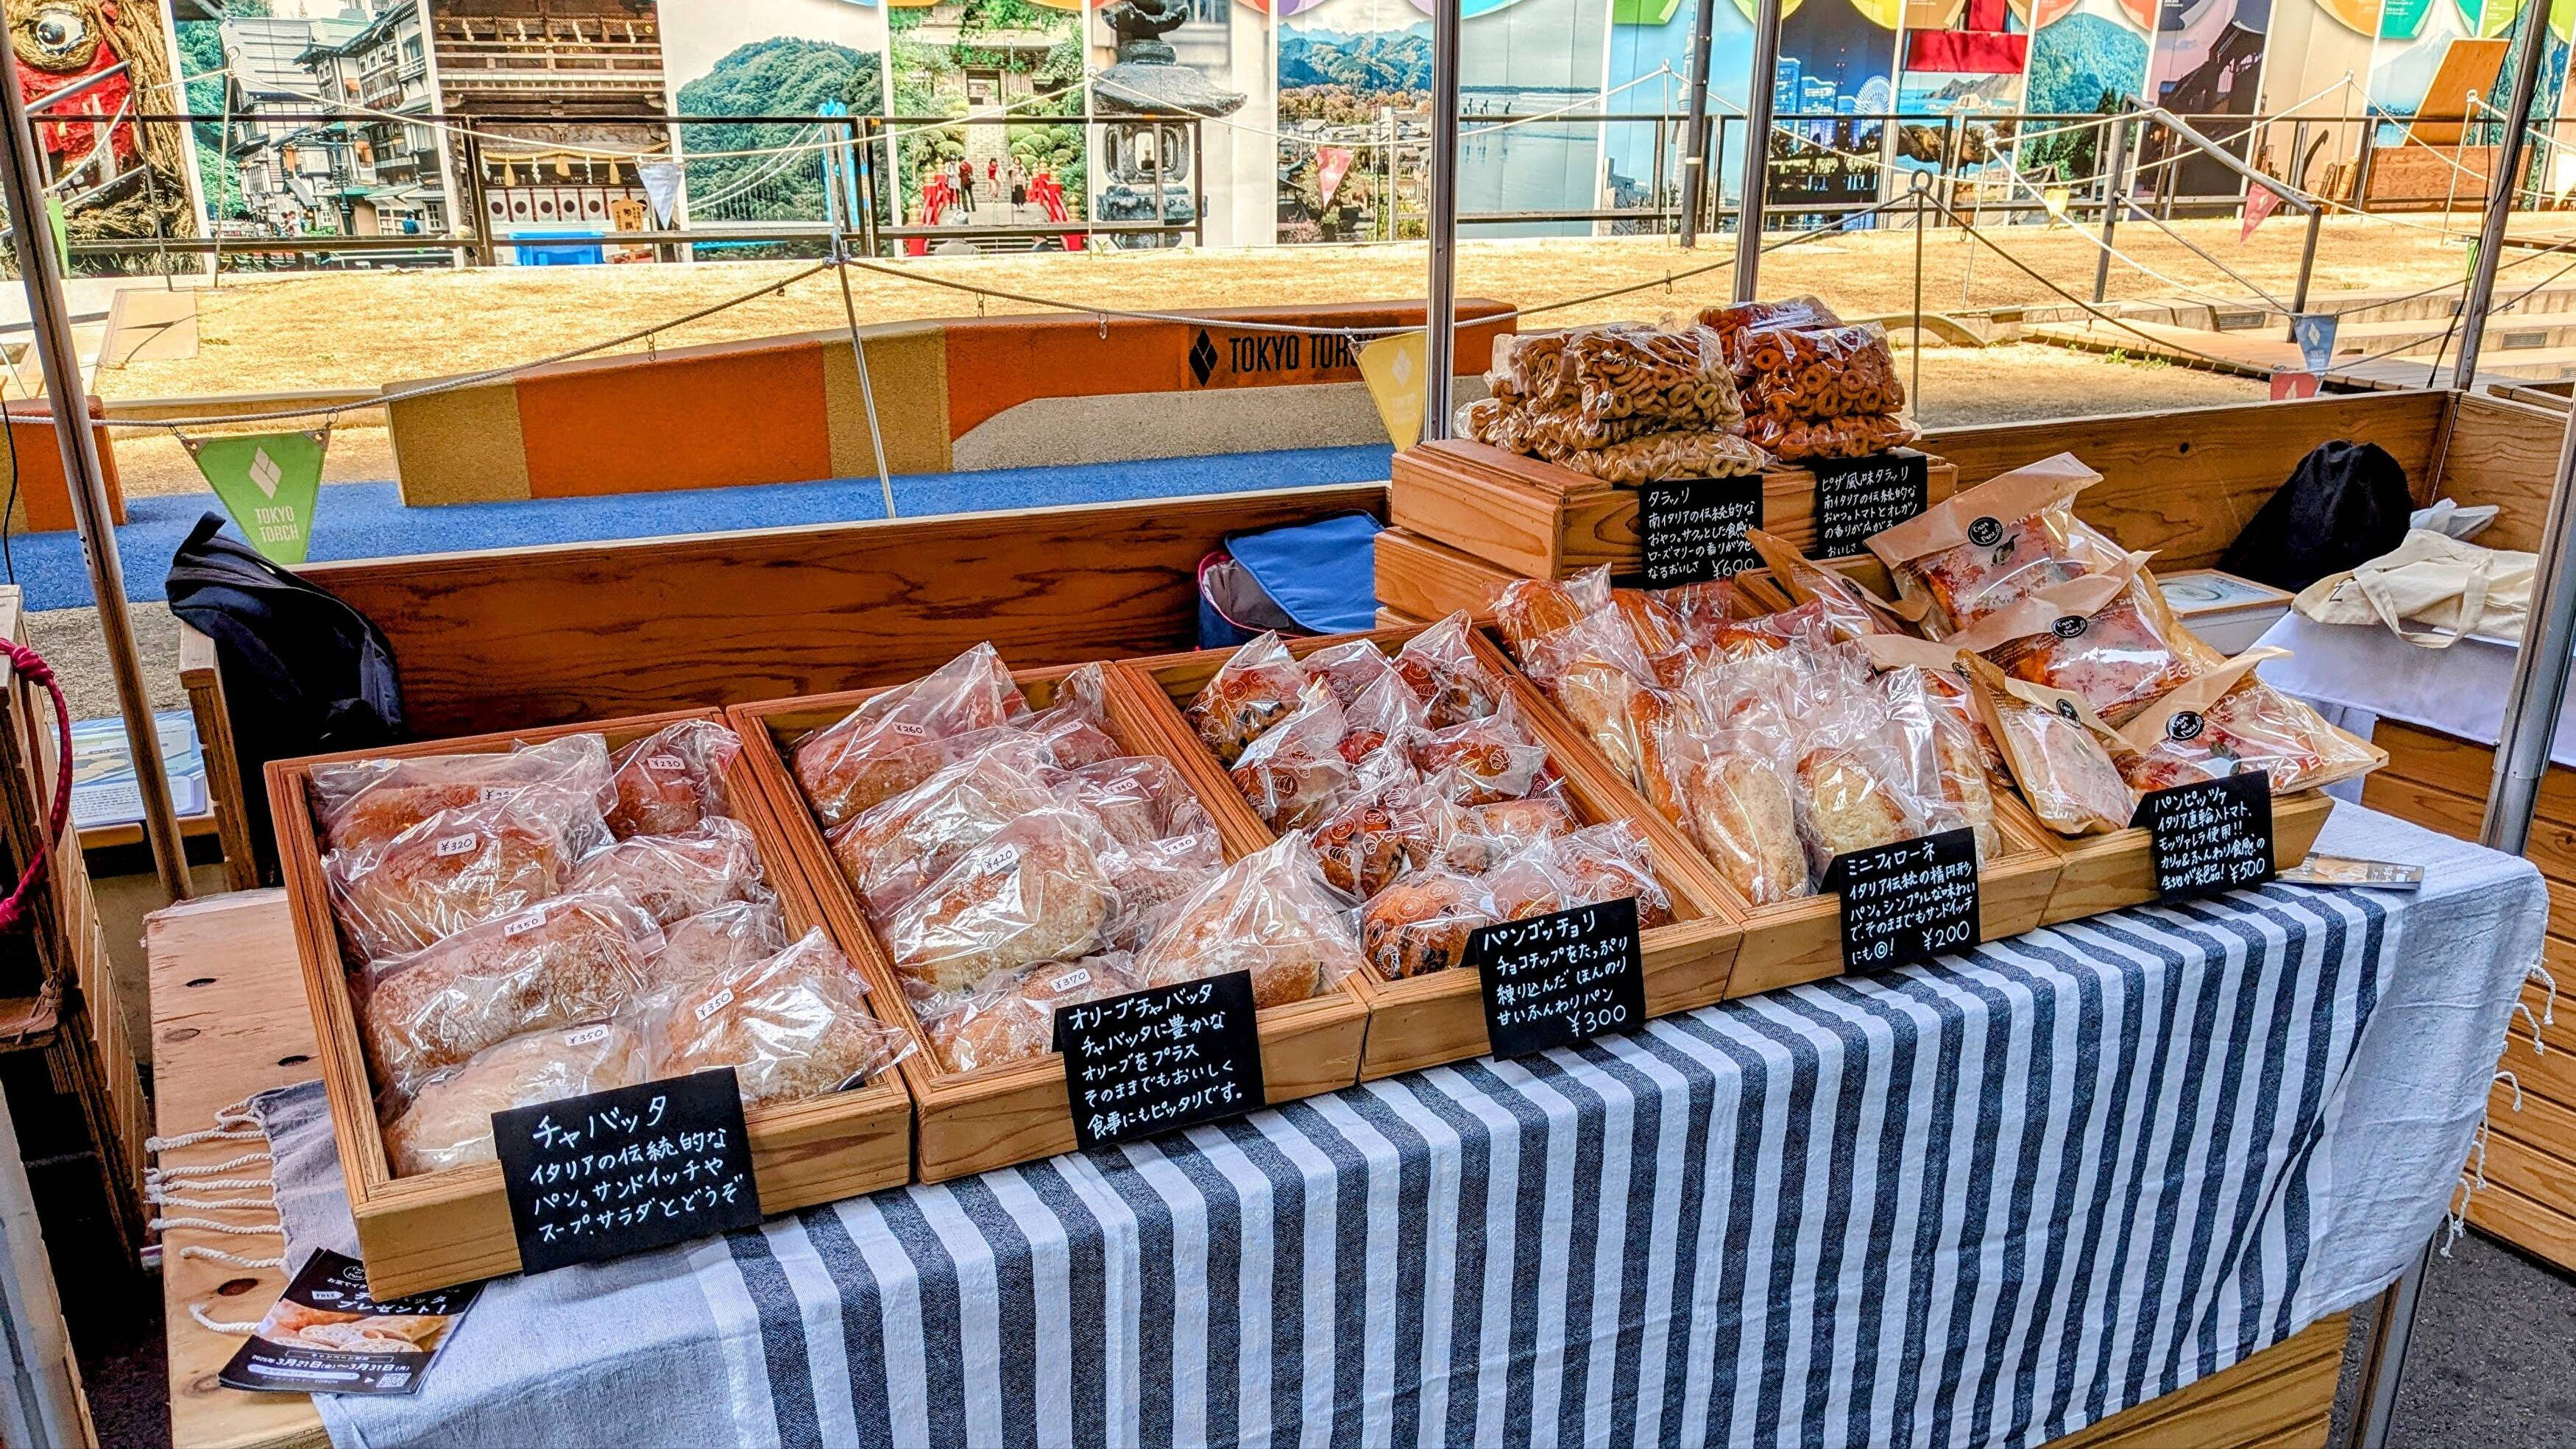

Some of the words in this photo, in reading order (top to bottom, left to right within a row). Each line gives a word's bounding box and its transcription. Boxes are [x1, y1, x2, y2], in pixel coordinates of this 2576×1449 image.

[1228, 334, 1299, 373] TOKYO
[1822, 466, 1908, 492] ピザ風味タラッリ
[1649, 487, 1690, 507] タラッリ
[254, 506, 294, 524] TOKYO
[259, 524, 299, 542] TORCH
[1648, 540, 1755, 561] ローズマリーの香りがクセ
[1827, 542, 1857, 558] おいしさ
[1648, 561, 1699, 579] なるおいしさ
[1711, 558, 1755, 579] ¥600
[894, 723, 923, 734] ¥260
[2154, 787, 2227, 812] パンピッツァ
[441, 838, 473, 852] ¥320
[984, 850, 1013, 870] ¥420
[1847, 841, 1935, 876] ミニフィローネ
[2229, 857, 2265, 884] ¥500
[507, 918, 539, 933] ¥350
[1484, 910, 1595, 951] パンゴッチョリ
[1922, 920, 1970, 951] ¥200
[1497, 936, 1627, 976] チョコチップをたっぷり
[1053, 971, 1086, 990] ¥370
[698, 992, 730, 1017] ¥350
[1069, 984, 1213, 1030] オリーブチャバッタ
[1081, 1010, 1225, 1057] チャバッタに豊かな
[1566, 1005, 1627, 1038] ¥300
[569, 1029, 604, 1044] ¥350
[1082, 1044, 1200, 1081] オリーブをプラス
[1085, 1060, 1234, 1108] そのままでもおいしく
[532, 1095, 667, 1149] チャバッタ
[1087, 1081, 1242, 1140] 食事にもピッタリです。
[530, 1128, 727, 1184] イタリアの伝統的な
[534, 1157, 723, 1216] パン。サンドイッチや
